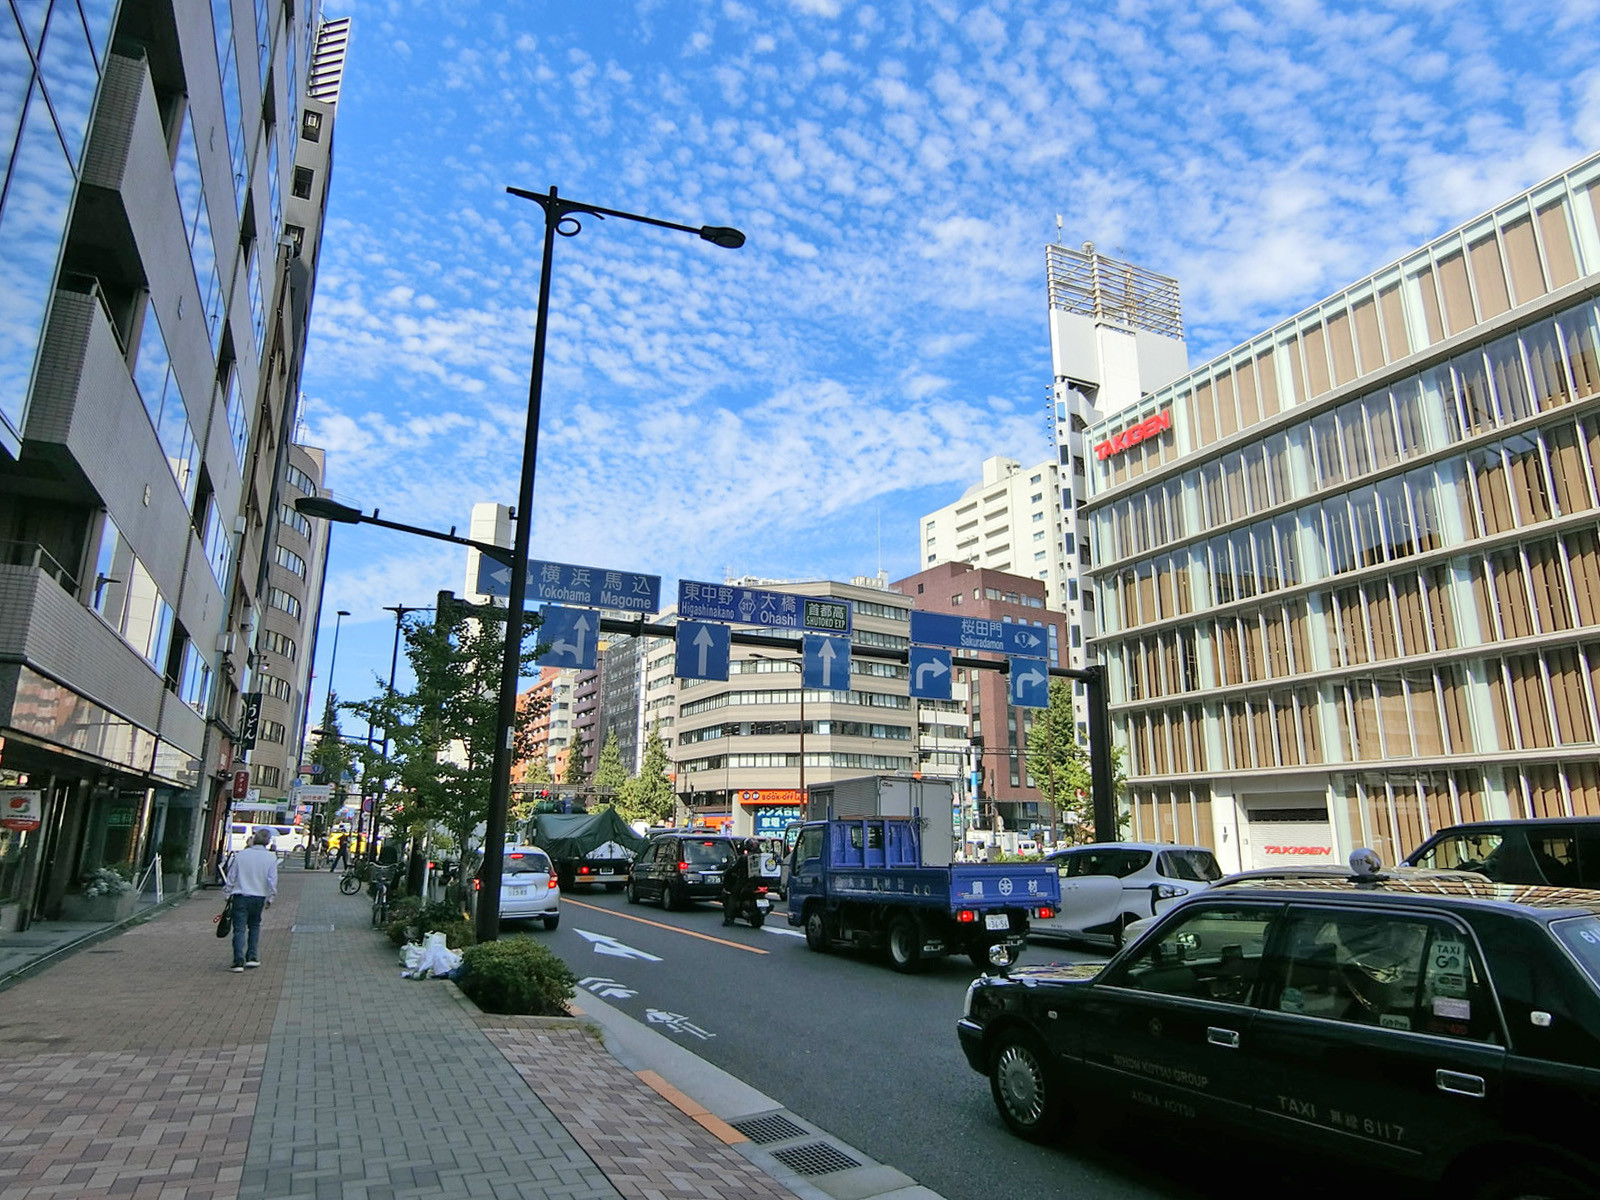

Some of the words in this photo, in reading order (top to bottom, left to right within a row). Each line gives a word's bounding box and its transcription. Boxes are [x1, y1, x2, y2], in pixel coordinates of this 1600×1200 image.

[1093, 409, 1170, 461] TAKIGEN
[540, 563, 591, 588] 横浜
[603, 571, 651, 596] 馬込
[538, 583, 591, 603] Yokohama
[600, 591, 651, 610] Magome
[684, 582, 734, 606] 東中野
[761, 593, 797, 613] 大橋
[681, 601, 735, 620] Higashinakano
[740, 602, 753, 612] 317
[808, 603, 845, 620] 首都高
[760, 610, 797, 627] Ohashi
[806, 615, 833, 628] SHUTOKO
[834, 618, 846, 629] EXP
[961, 618, 1003, 638] 桜田門
[960, 634, 1004, 651] Sakuradamon
[244, 703, 258, 740] うどん
[1264, 845, 1332, 856] TAKIGEN
[1437, 944, 1460, 954] TAXI
[1174, 1069, 1208, 1088] GROUP
[1278, 1094, 1316, 1118] TAXI
[1363, 1118, 1405, 1141] 6117
